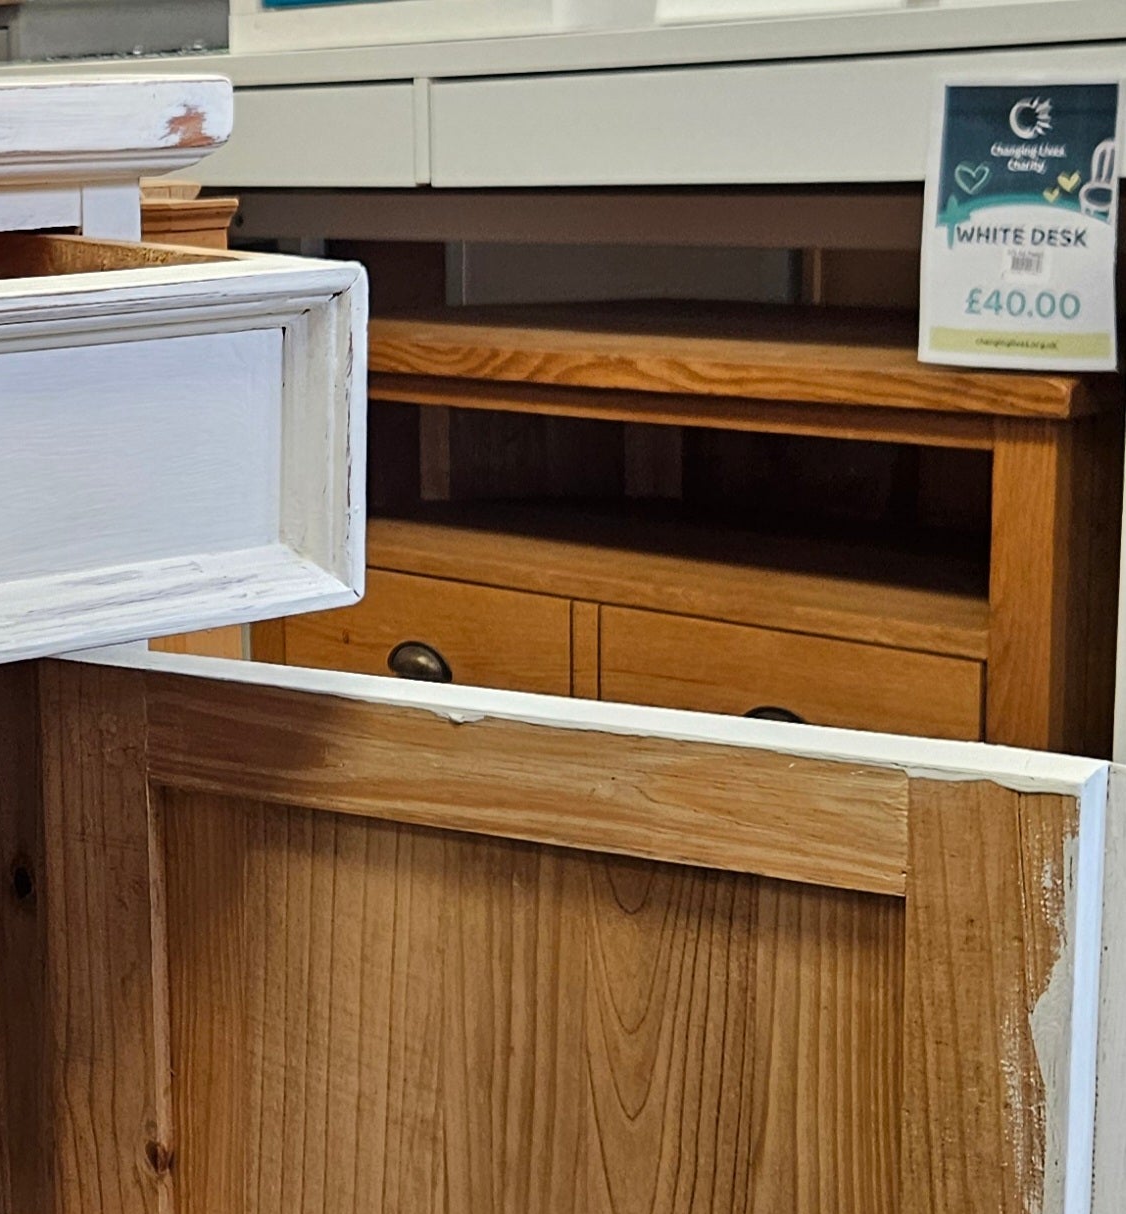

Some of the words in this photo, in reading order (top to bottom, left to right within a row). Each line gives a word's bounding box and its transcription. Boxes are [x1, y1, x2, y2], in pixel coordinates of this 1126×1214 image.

[956, 225, 1025, 245] WHITE
[1031, 227, 1088, 248] DESK
[964, 288, 1082, 319] £40.00
